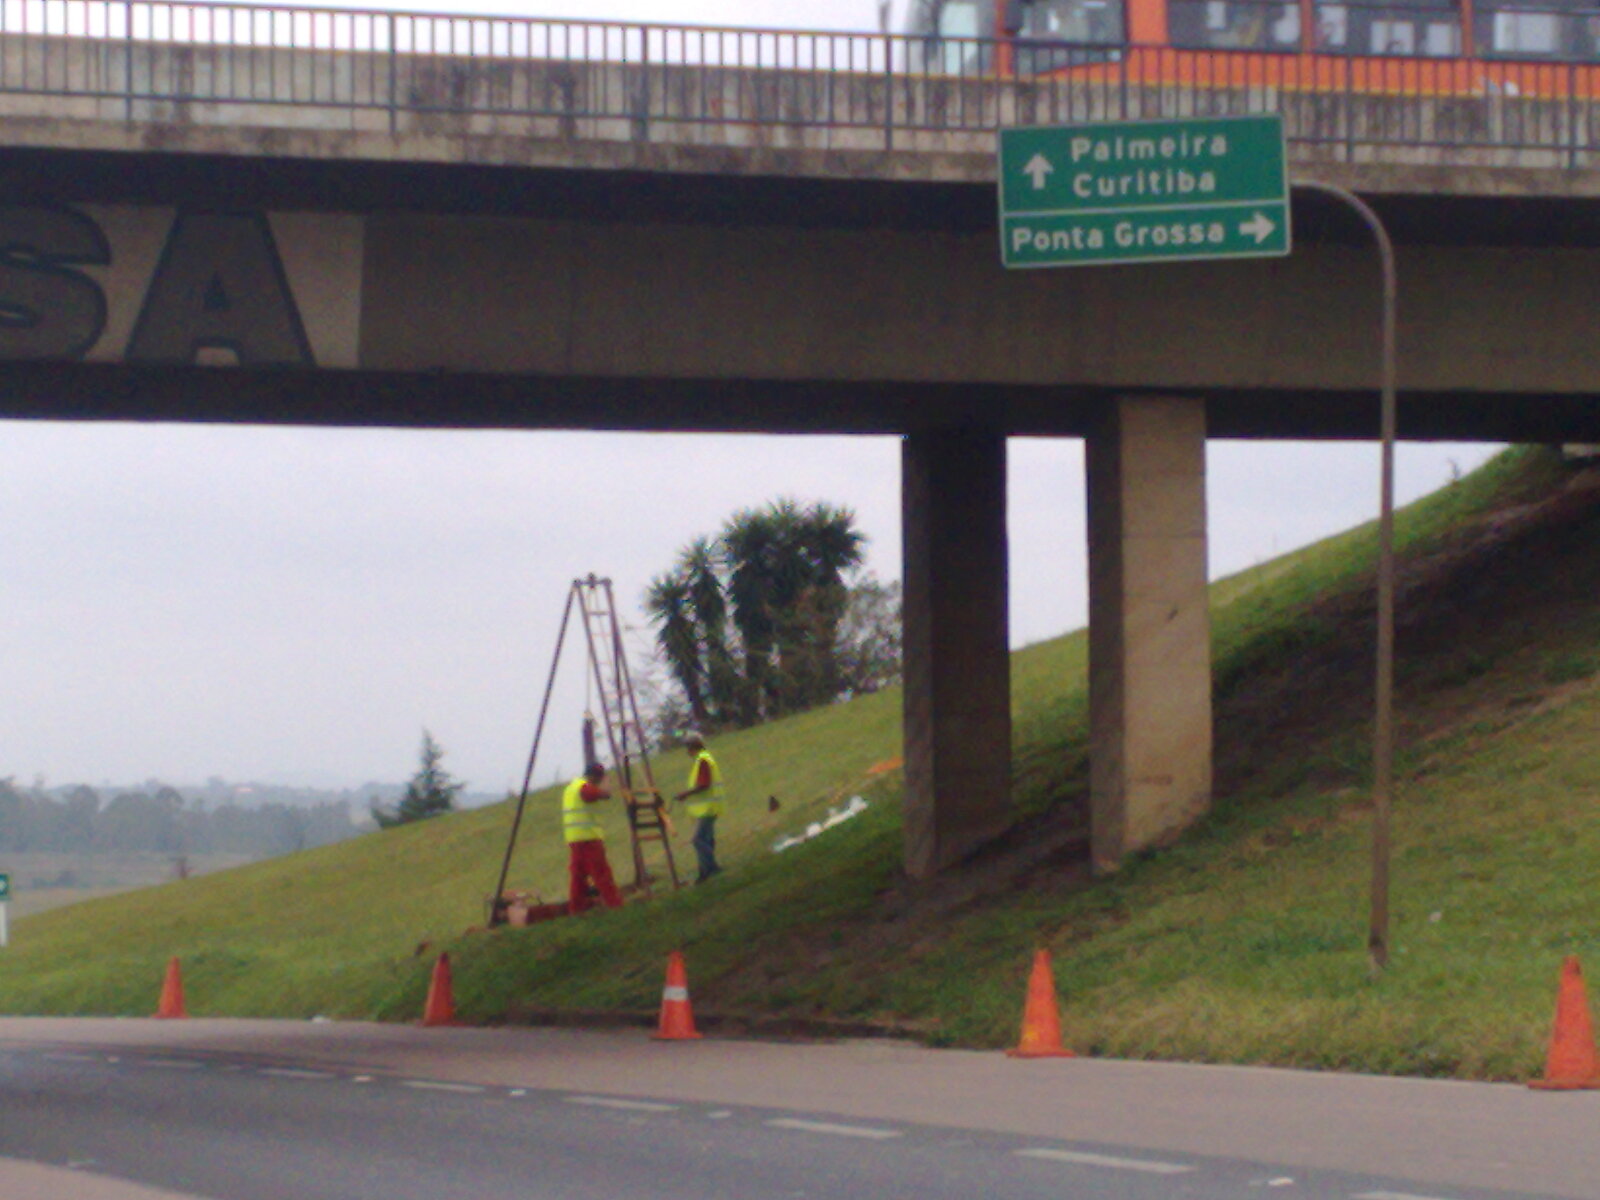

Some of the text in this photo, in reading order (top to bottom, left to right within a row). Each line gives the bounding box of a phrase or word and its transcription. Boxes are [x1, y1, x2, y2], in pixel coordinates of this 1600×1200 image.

[1070, 131, 1227, 163] Palmeira
[1072, 168, 1217, 198] Curitiba
[1012, 221, 1225, 253] Ponta Grossa
